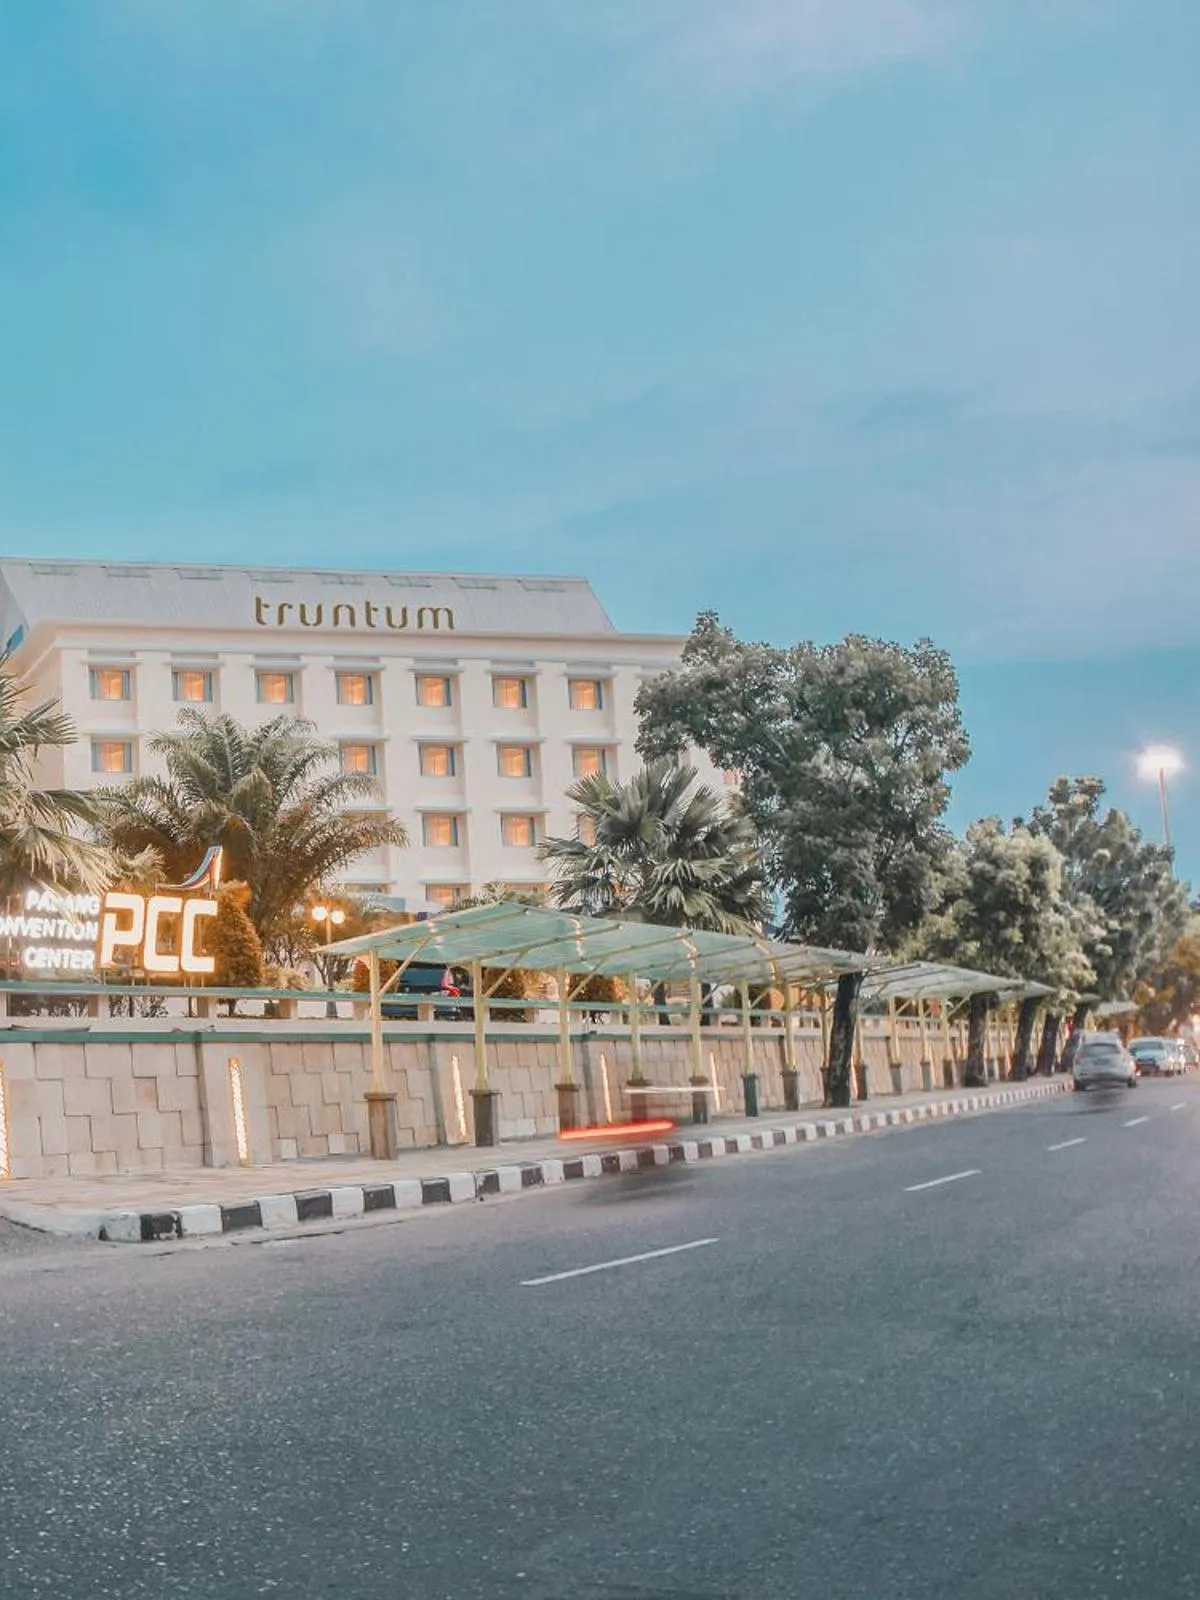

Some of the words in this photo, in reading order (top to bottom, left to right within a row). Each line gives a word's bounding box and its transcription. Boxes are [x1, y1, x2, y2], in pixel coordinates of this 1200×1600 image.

[255, 596, 455, 630] truntum
[100, 892, 219, 973] PCC
[23, 946, 95, 970] CENTER
